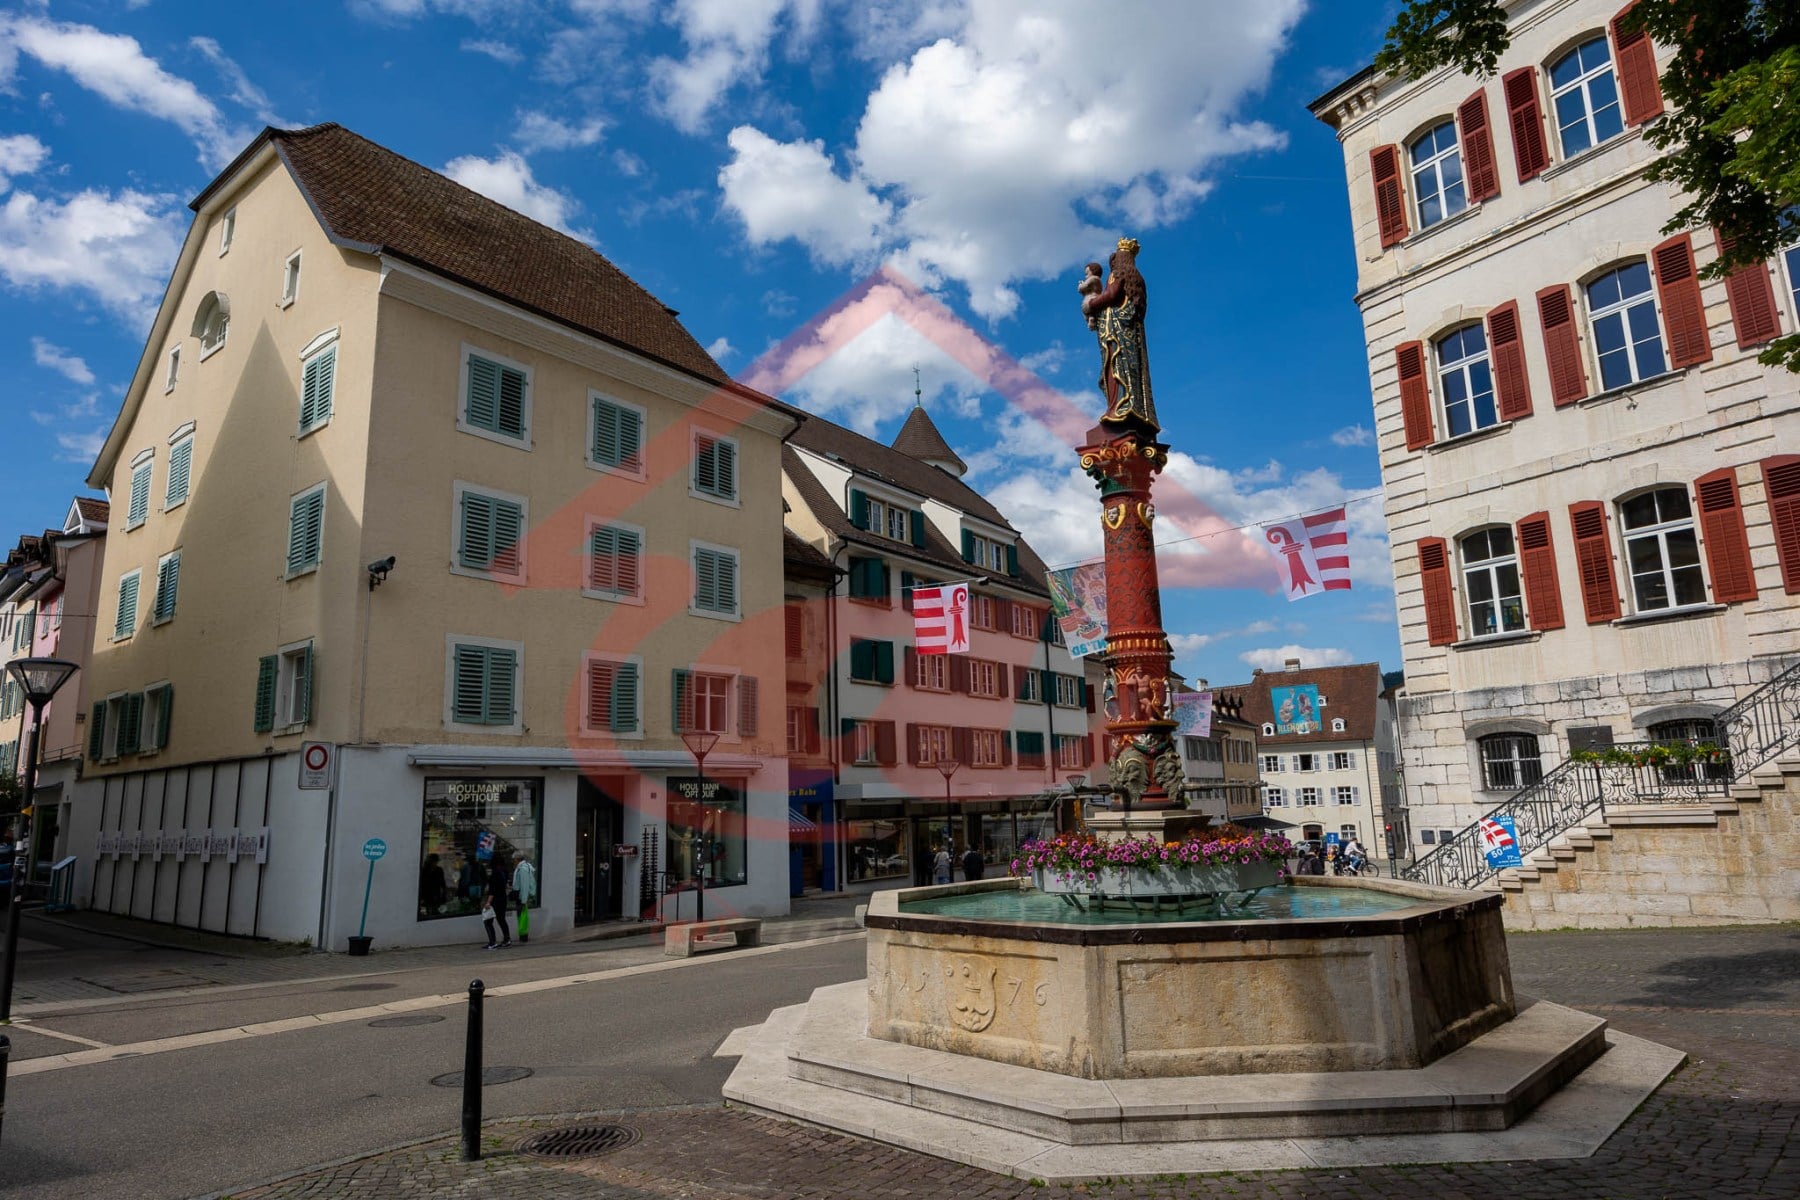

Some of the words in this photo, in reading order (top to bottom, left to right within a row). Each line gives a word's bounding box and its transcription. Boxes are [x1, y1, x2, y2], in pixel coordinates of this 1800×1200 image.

[449, 784, 507, 793] HOULMANN
[680, 783, 719, 791] HOULANN
[456, 793, 499, 803] OPTIQUE
[685, 790, 715, 799] OPTQUE
[1491, 848, 1503, 859] 50
